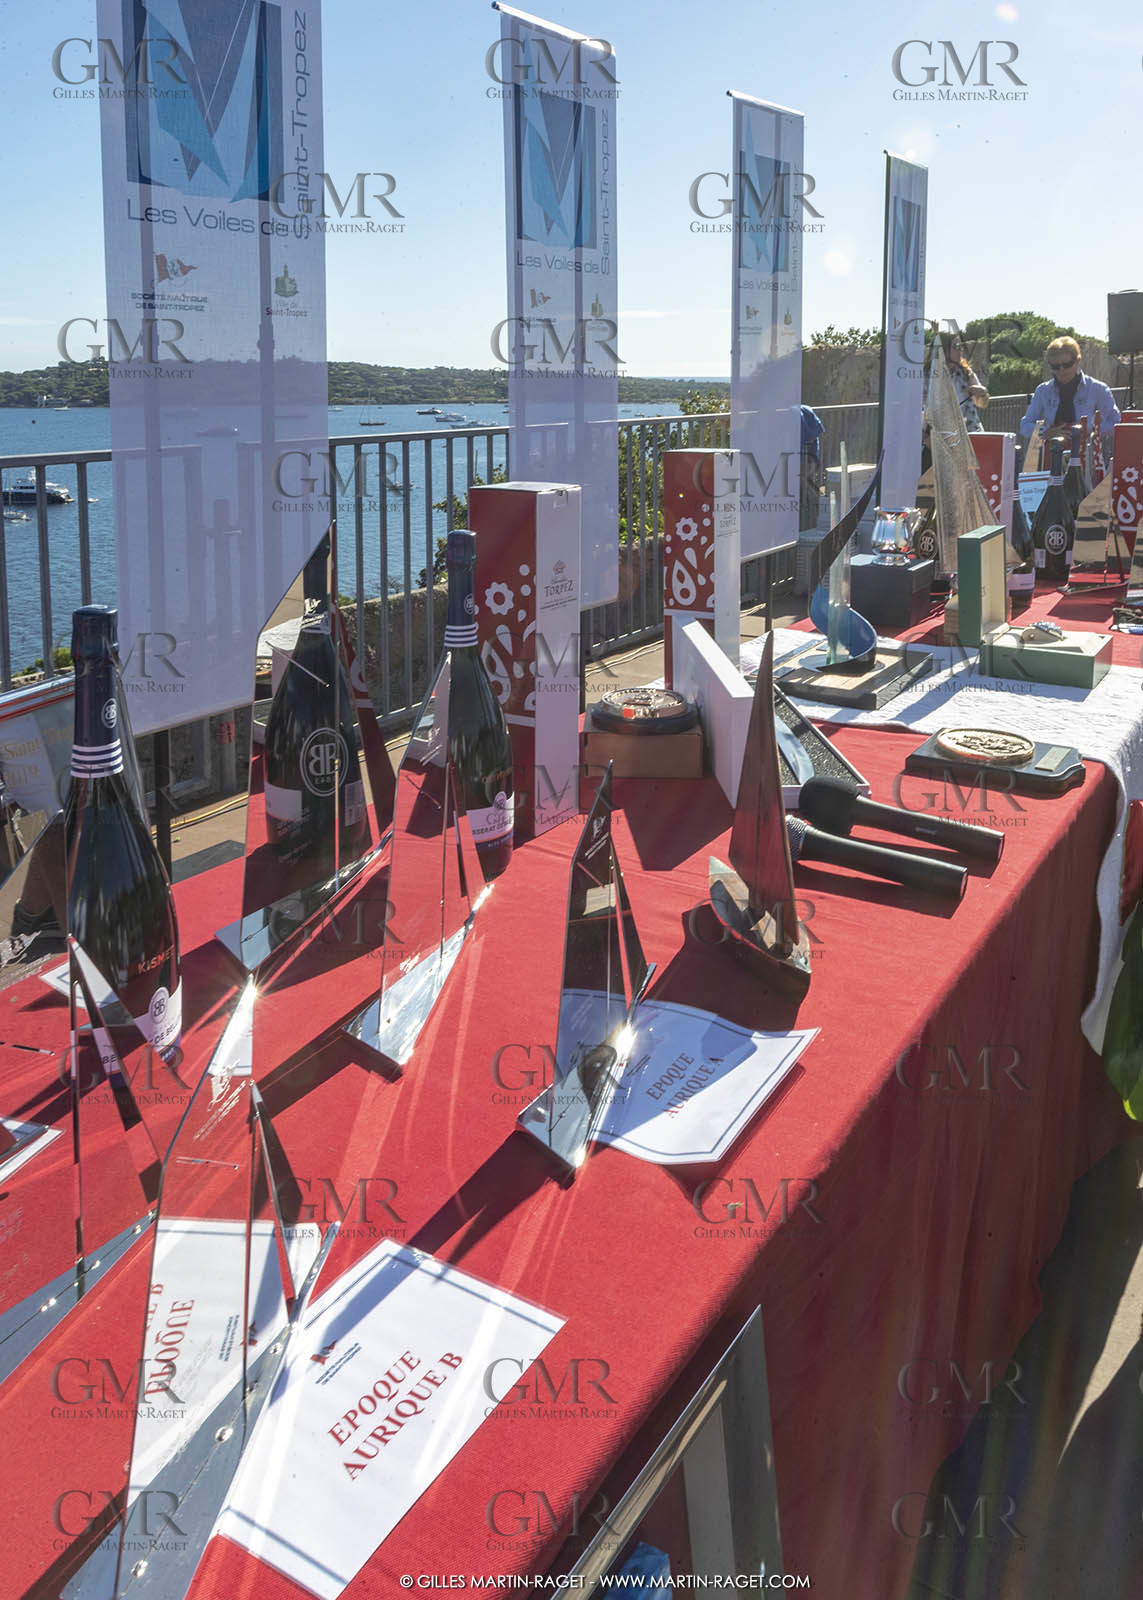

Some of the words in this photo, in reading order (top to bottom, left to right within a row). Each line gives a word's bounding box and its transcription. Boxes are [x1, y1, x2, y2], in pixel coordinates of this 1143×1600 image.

[292, 10, 310, 240] Saint-Tropez
[127, 199, 177, 225] Les
[183, 206, 255, 233] Voiles
[260, 216, 289, 238] de
[517, 251, 541, 268] Les
[544, 254, 582, 272] Voiles
[583, 261, 599, 274] de
[646, 1052, 694, 1100] EPOQUE
[664, 1064, 716, 1118] AURIQUE
[709, 1057, 724, 1066] A
[328, 1350, 421, 1447] EPOQUE
[343, 1369, 447, 1480] AURIQUE
[438, 1352, 463, 1371] B
